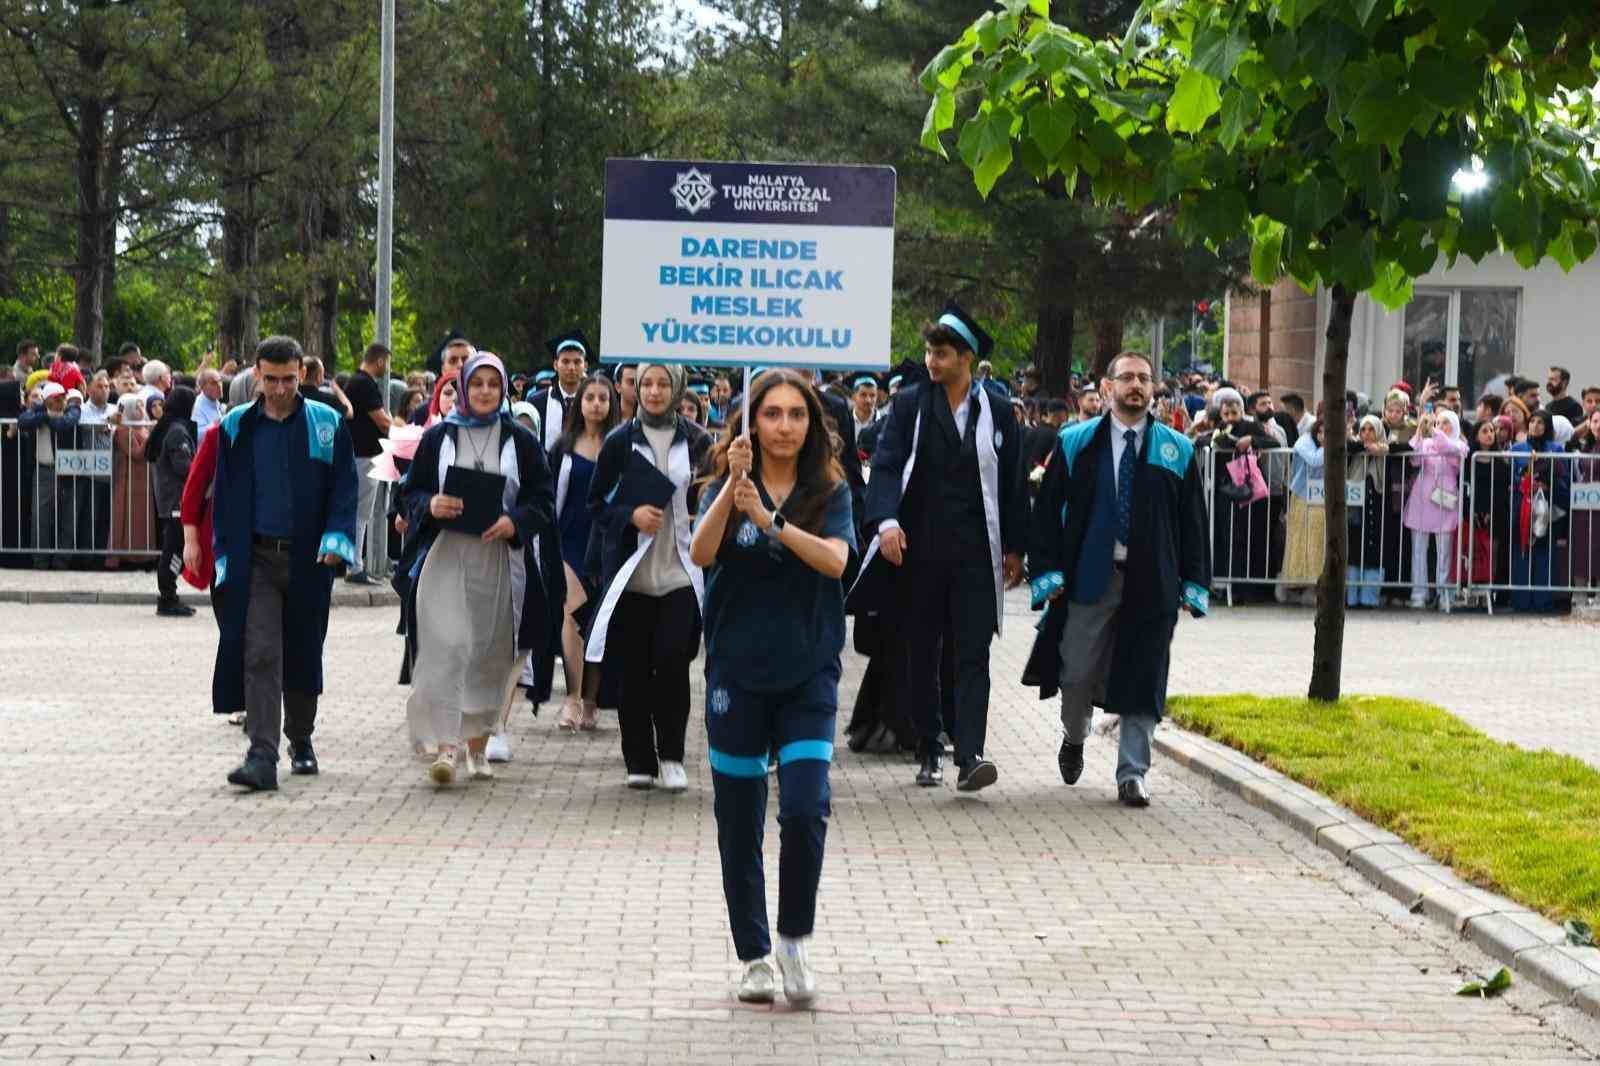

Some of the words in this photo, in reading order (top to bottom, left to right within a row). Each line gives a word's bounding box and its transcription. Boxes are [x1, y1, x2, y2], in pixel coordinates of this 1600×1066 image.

[722, 184, 785, 200] TURGUT
[748, 174, 805, 187] MALATYA
[681, 237, 817, 261] DARENDE
[659, 263, 743, 288] BEKİR
[750, 268, 844, 290] ILICAK
[690, 295, 803, 318] MESLEK
[641, 318, 852, 349] YÜKSEKOKULU
